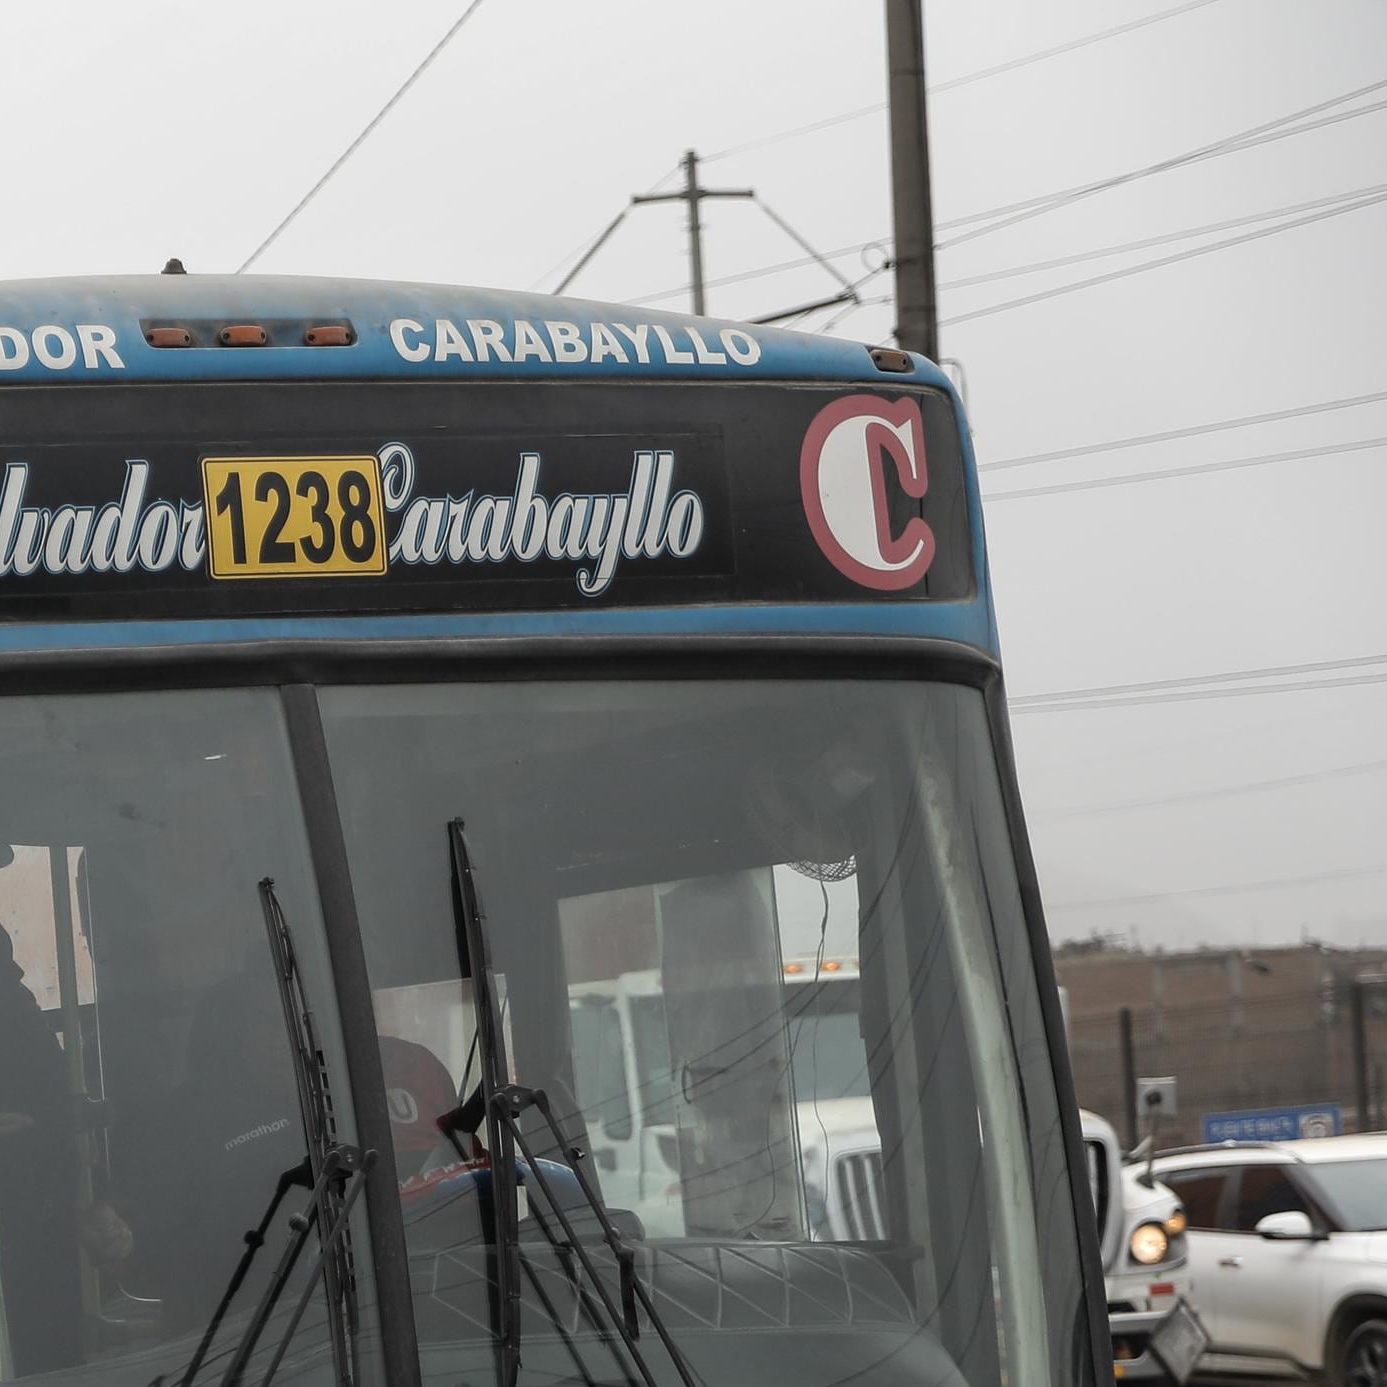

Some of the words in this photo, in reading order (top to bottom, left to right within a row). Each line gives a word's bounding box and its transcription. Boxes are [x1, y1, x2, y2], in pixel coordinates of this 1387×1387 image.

[389, 318, 763, 366] CARABAYLLO
[216, 470, 376, 565] 1238
[224, 1117, 290, 1150] marathon
